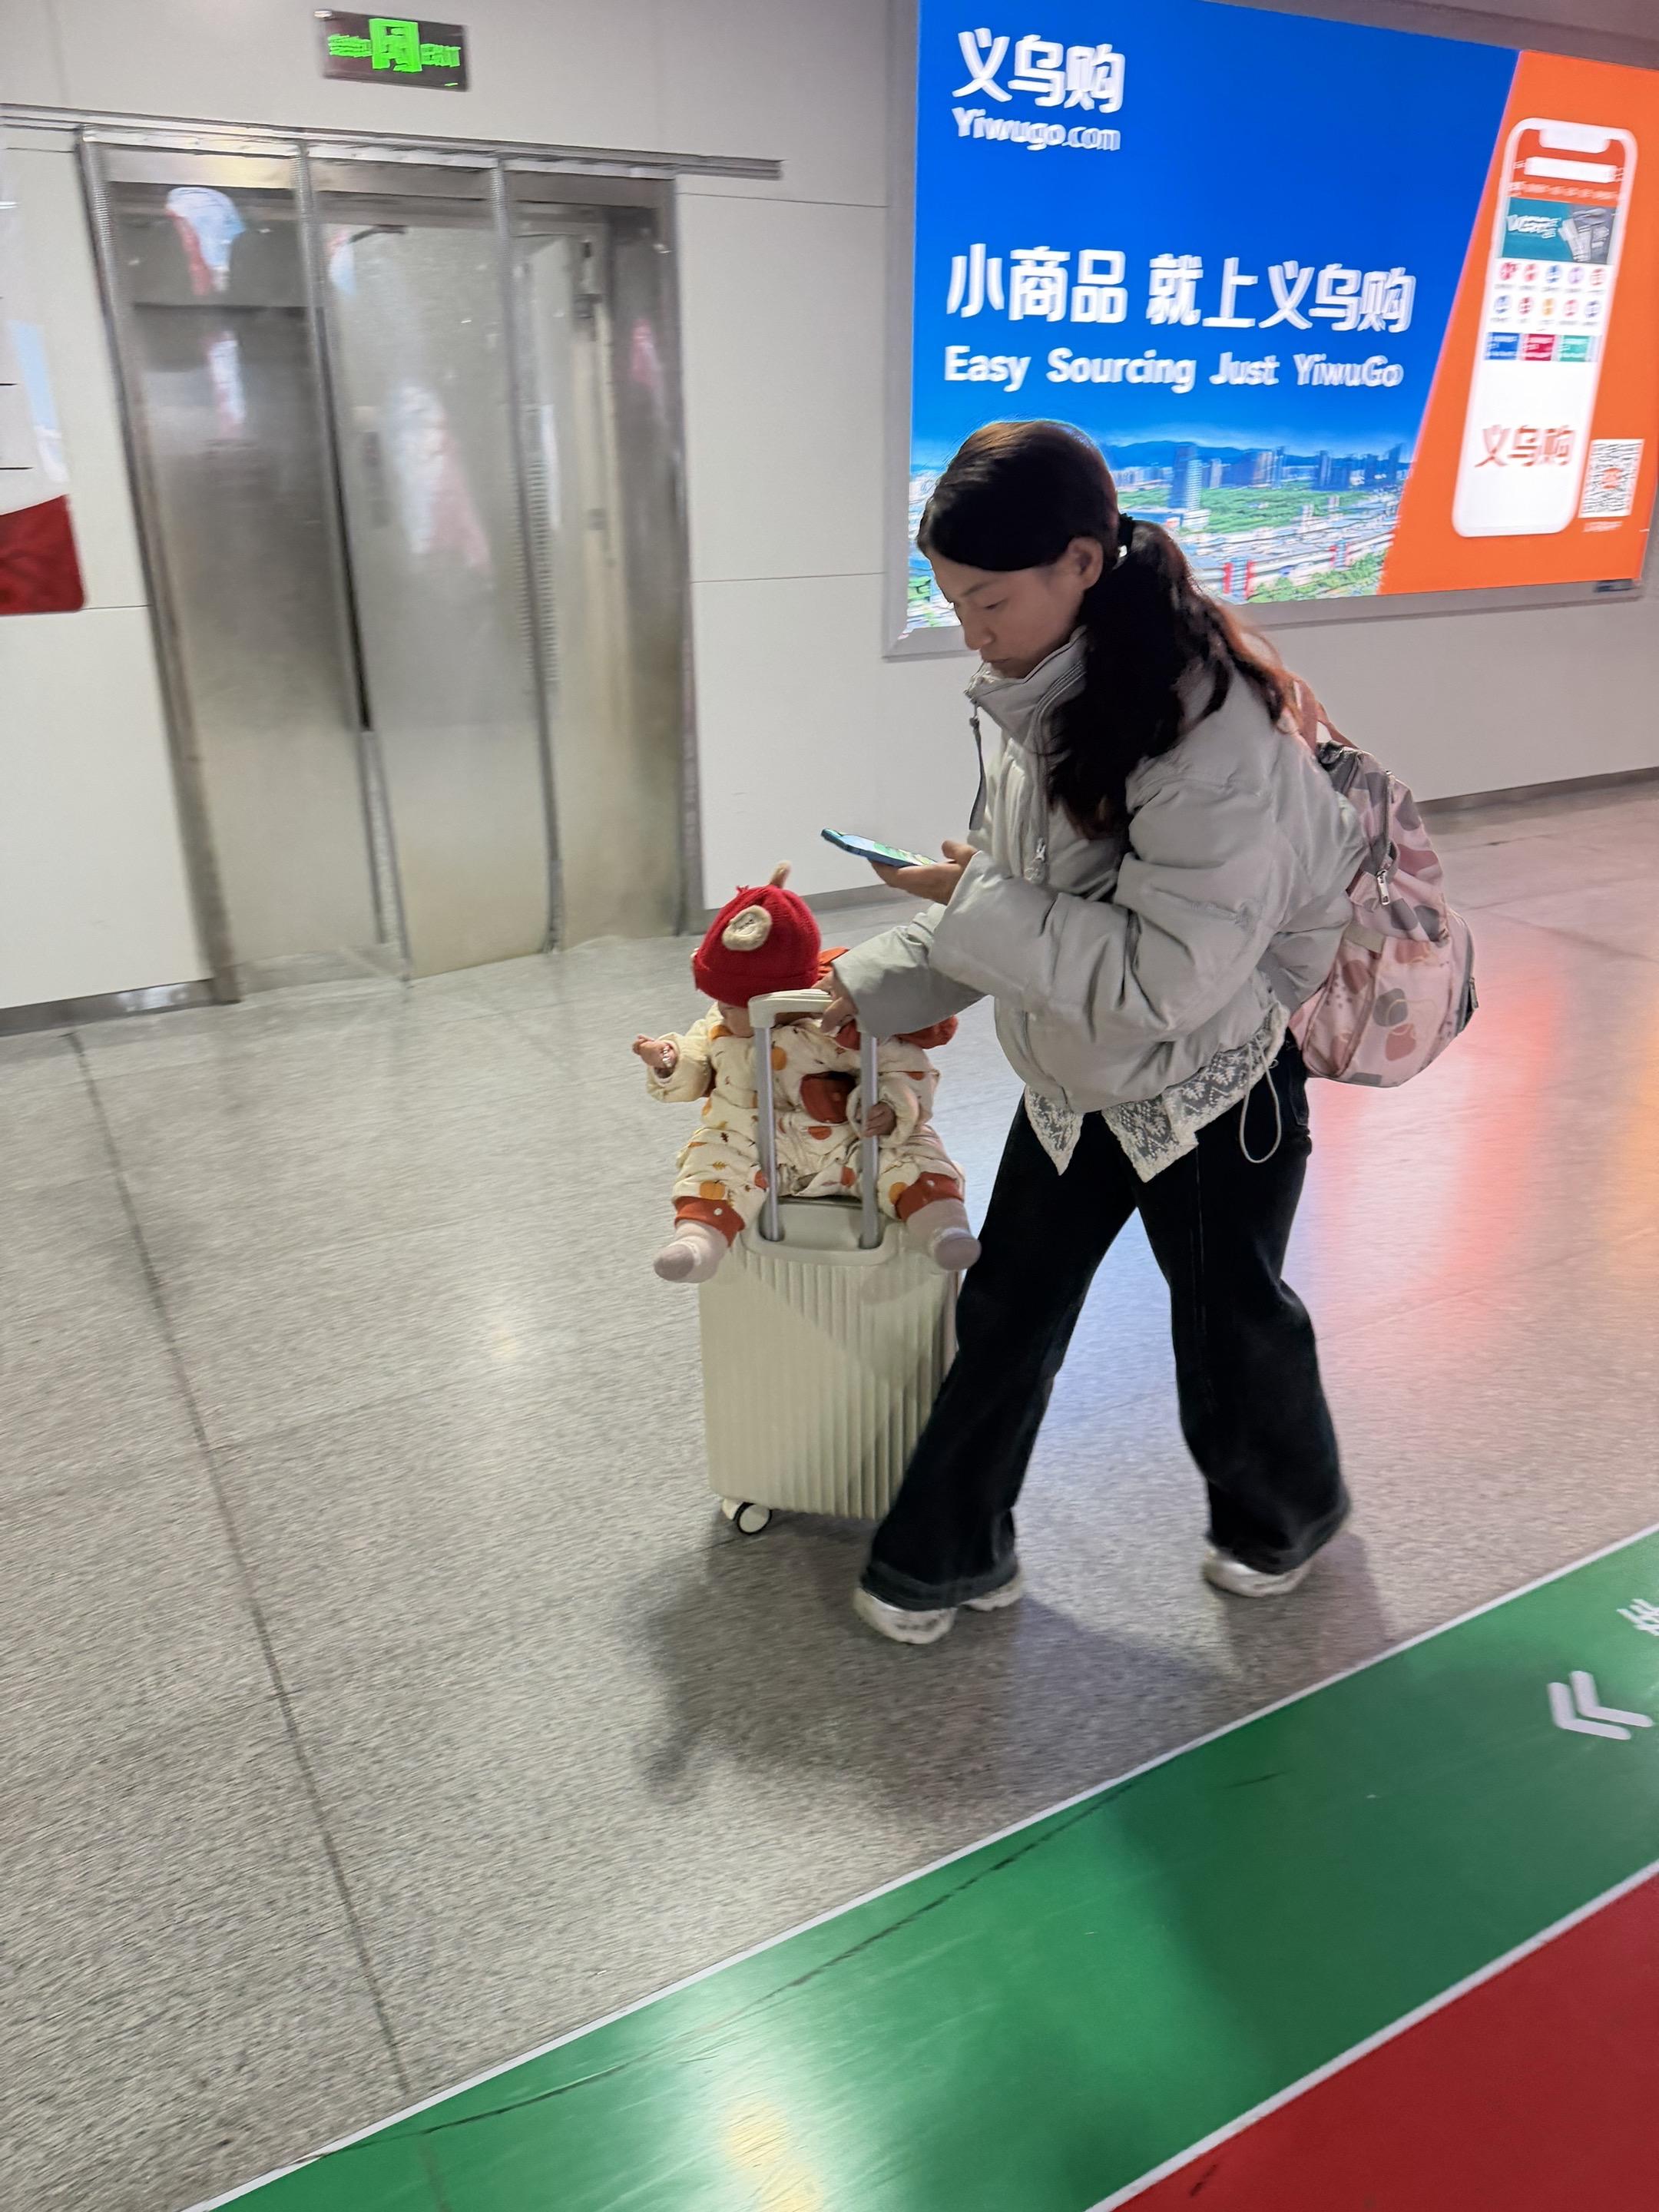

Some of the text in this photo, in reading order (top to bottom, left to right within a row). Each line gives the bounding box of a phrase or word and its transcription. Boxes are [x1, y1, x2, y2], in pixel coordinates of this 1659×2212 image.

[952, 28, 1126, 114] 义乌购
[952, 107, 1121, 151] Yiwugo.com
[946, 243, 1416, 333] 小商品 就上义乌购
[944, 345, 1405, 394] Easy Sourcing Just YiwuGo
[1474, 424, 1575, 468] 义乌购
